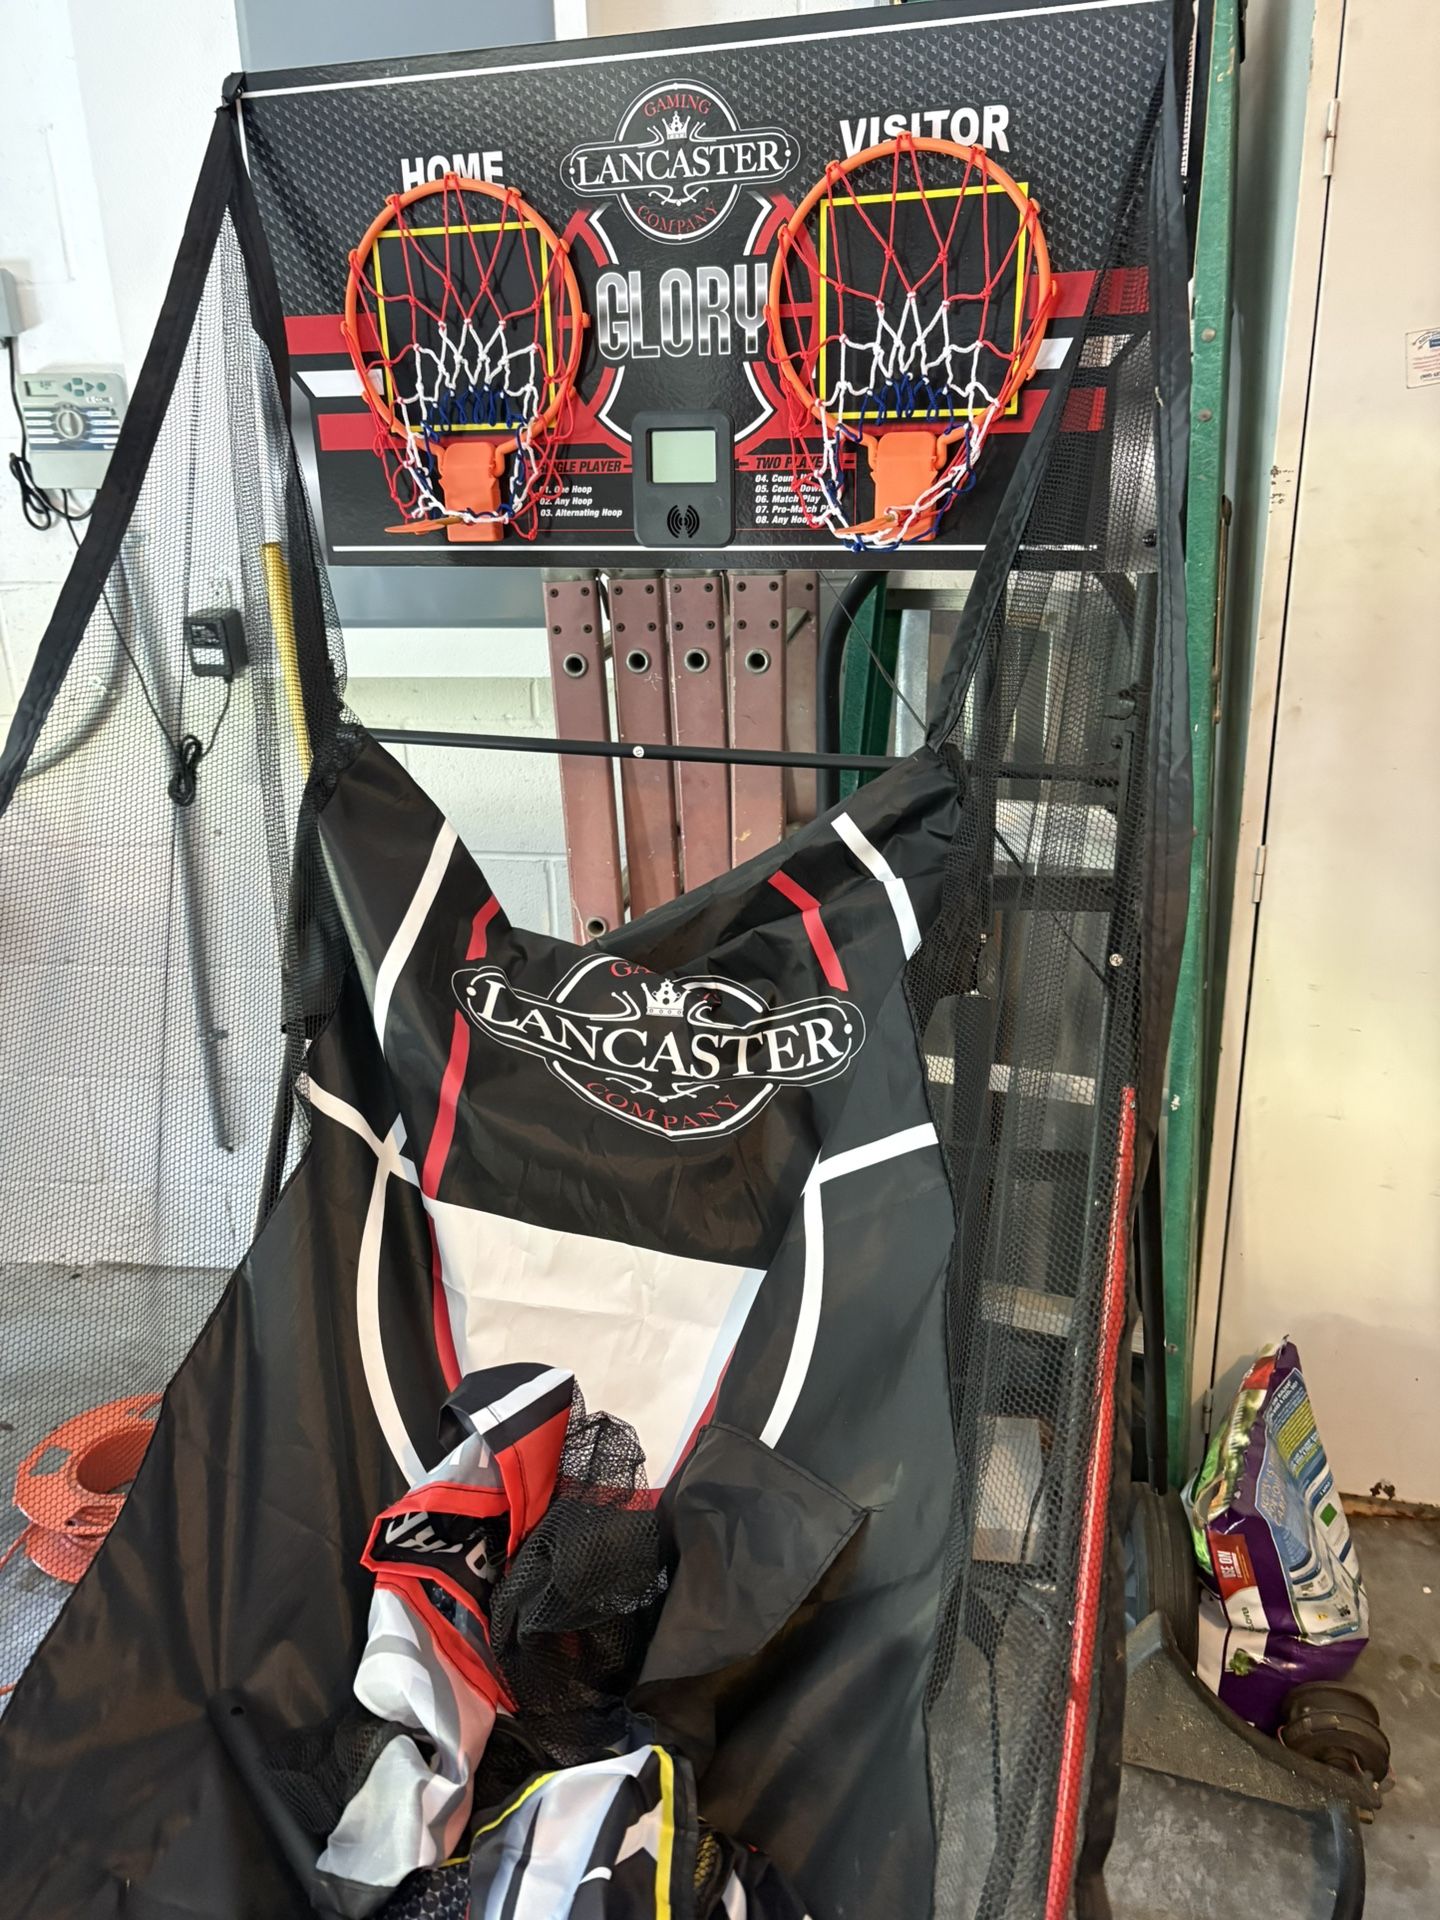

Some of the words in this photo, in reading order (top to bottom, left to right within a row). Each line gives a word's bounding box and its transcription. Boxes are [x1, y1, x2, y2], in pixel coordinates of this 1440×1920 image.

[643, 94, 712, 117] GAMING
[840, 105, 1010, 159] VISITOR
[576, 140, 784, 187] LANCASTER
[401, 151, 506, 193] HOME
[637, 201, 718, 233] COMPANY
[596, 263, 769, 361] GLORY
[540, 461, 576, 473] SNGLE
[579, 460, 622, 473] PLAYER
[757, 457, 781, 469] TWO
[755, 474, 769, 483] 04.
[771, 474, 798, 483] Coun
[571, 485, 593, 495] Hoop
[755, 485, 769, 493] 05.
[771, 485, 797, 493] Coun
[540, 498, 552, 506] 02.
[554, 498, 571, 507] Any
[572, 497, 593, 507] Hoop
[755, 495, 769, 504] 06.
[771, 495, 800, 504] Match
[802, 494, 821, 505] Play
[540, 509, 553, 518] 03.
[555, 509, 600, 519] Alternating
[602, 508, 623, 519] Hoop
[755, 505, 769, 514] 07.
[771, 504, 818, 515] Pro-Mach
[755, 516, 769, 524] 08.
[771, 515, 789, 526] Any
[477, 979, 844, 1080] LANCASTER
[586, 1082, 740, 1130] COMPANY
[1217, 1550, 1233, 1565] ON
